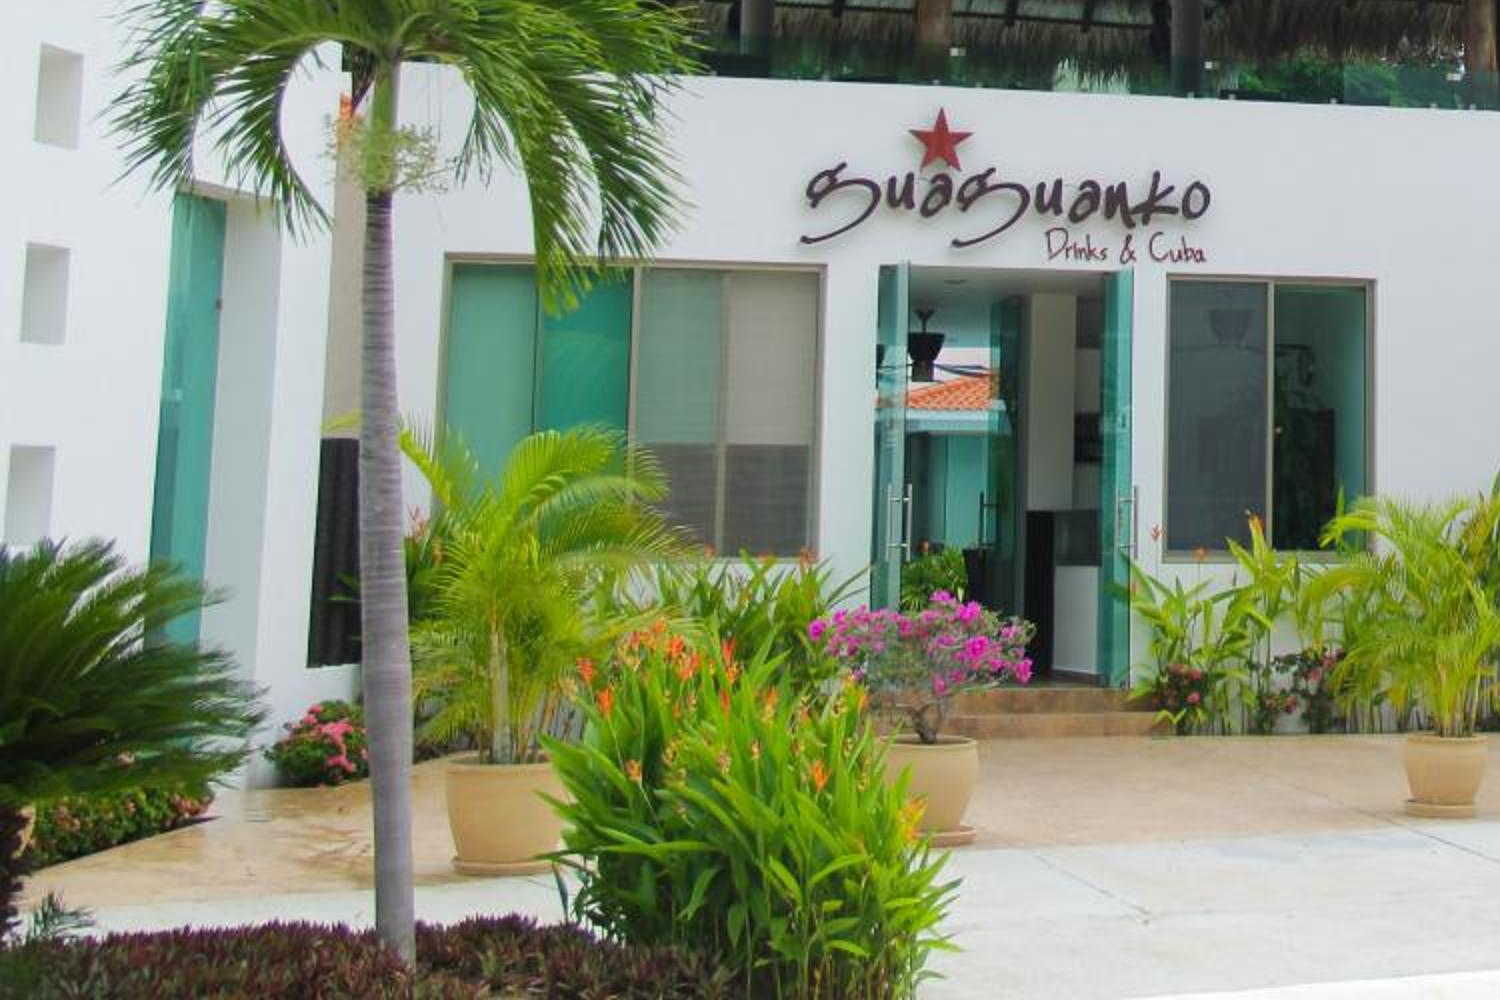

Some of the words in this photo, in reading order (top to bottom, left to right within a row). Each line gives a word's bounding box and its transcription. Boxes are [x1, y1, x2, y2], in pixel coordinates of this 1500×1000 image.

[1045, 227, 1108, 262] Drinks
[1120, 233, 1136, 264] &
[1150, 231, 1206, 262] Cuba
